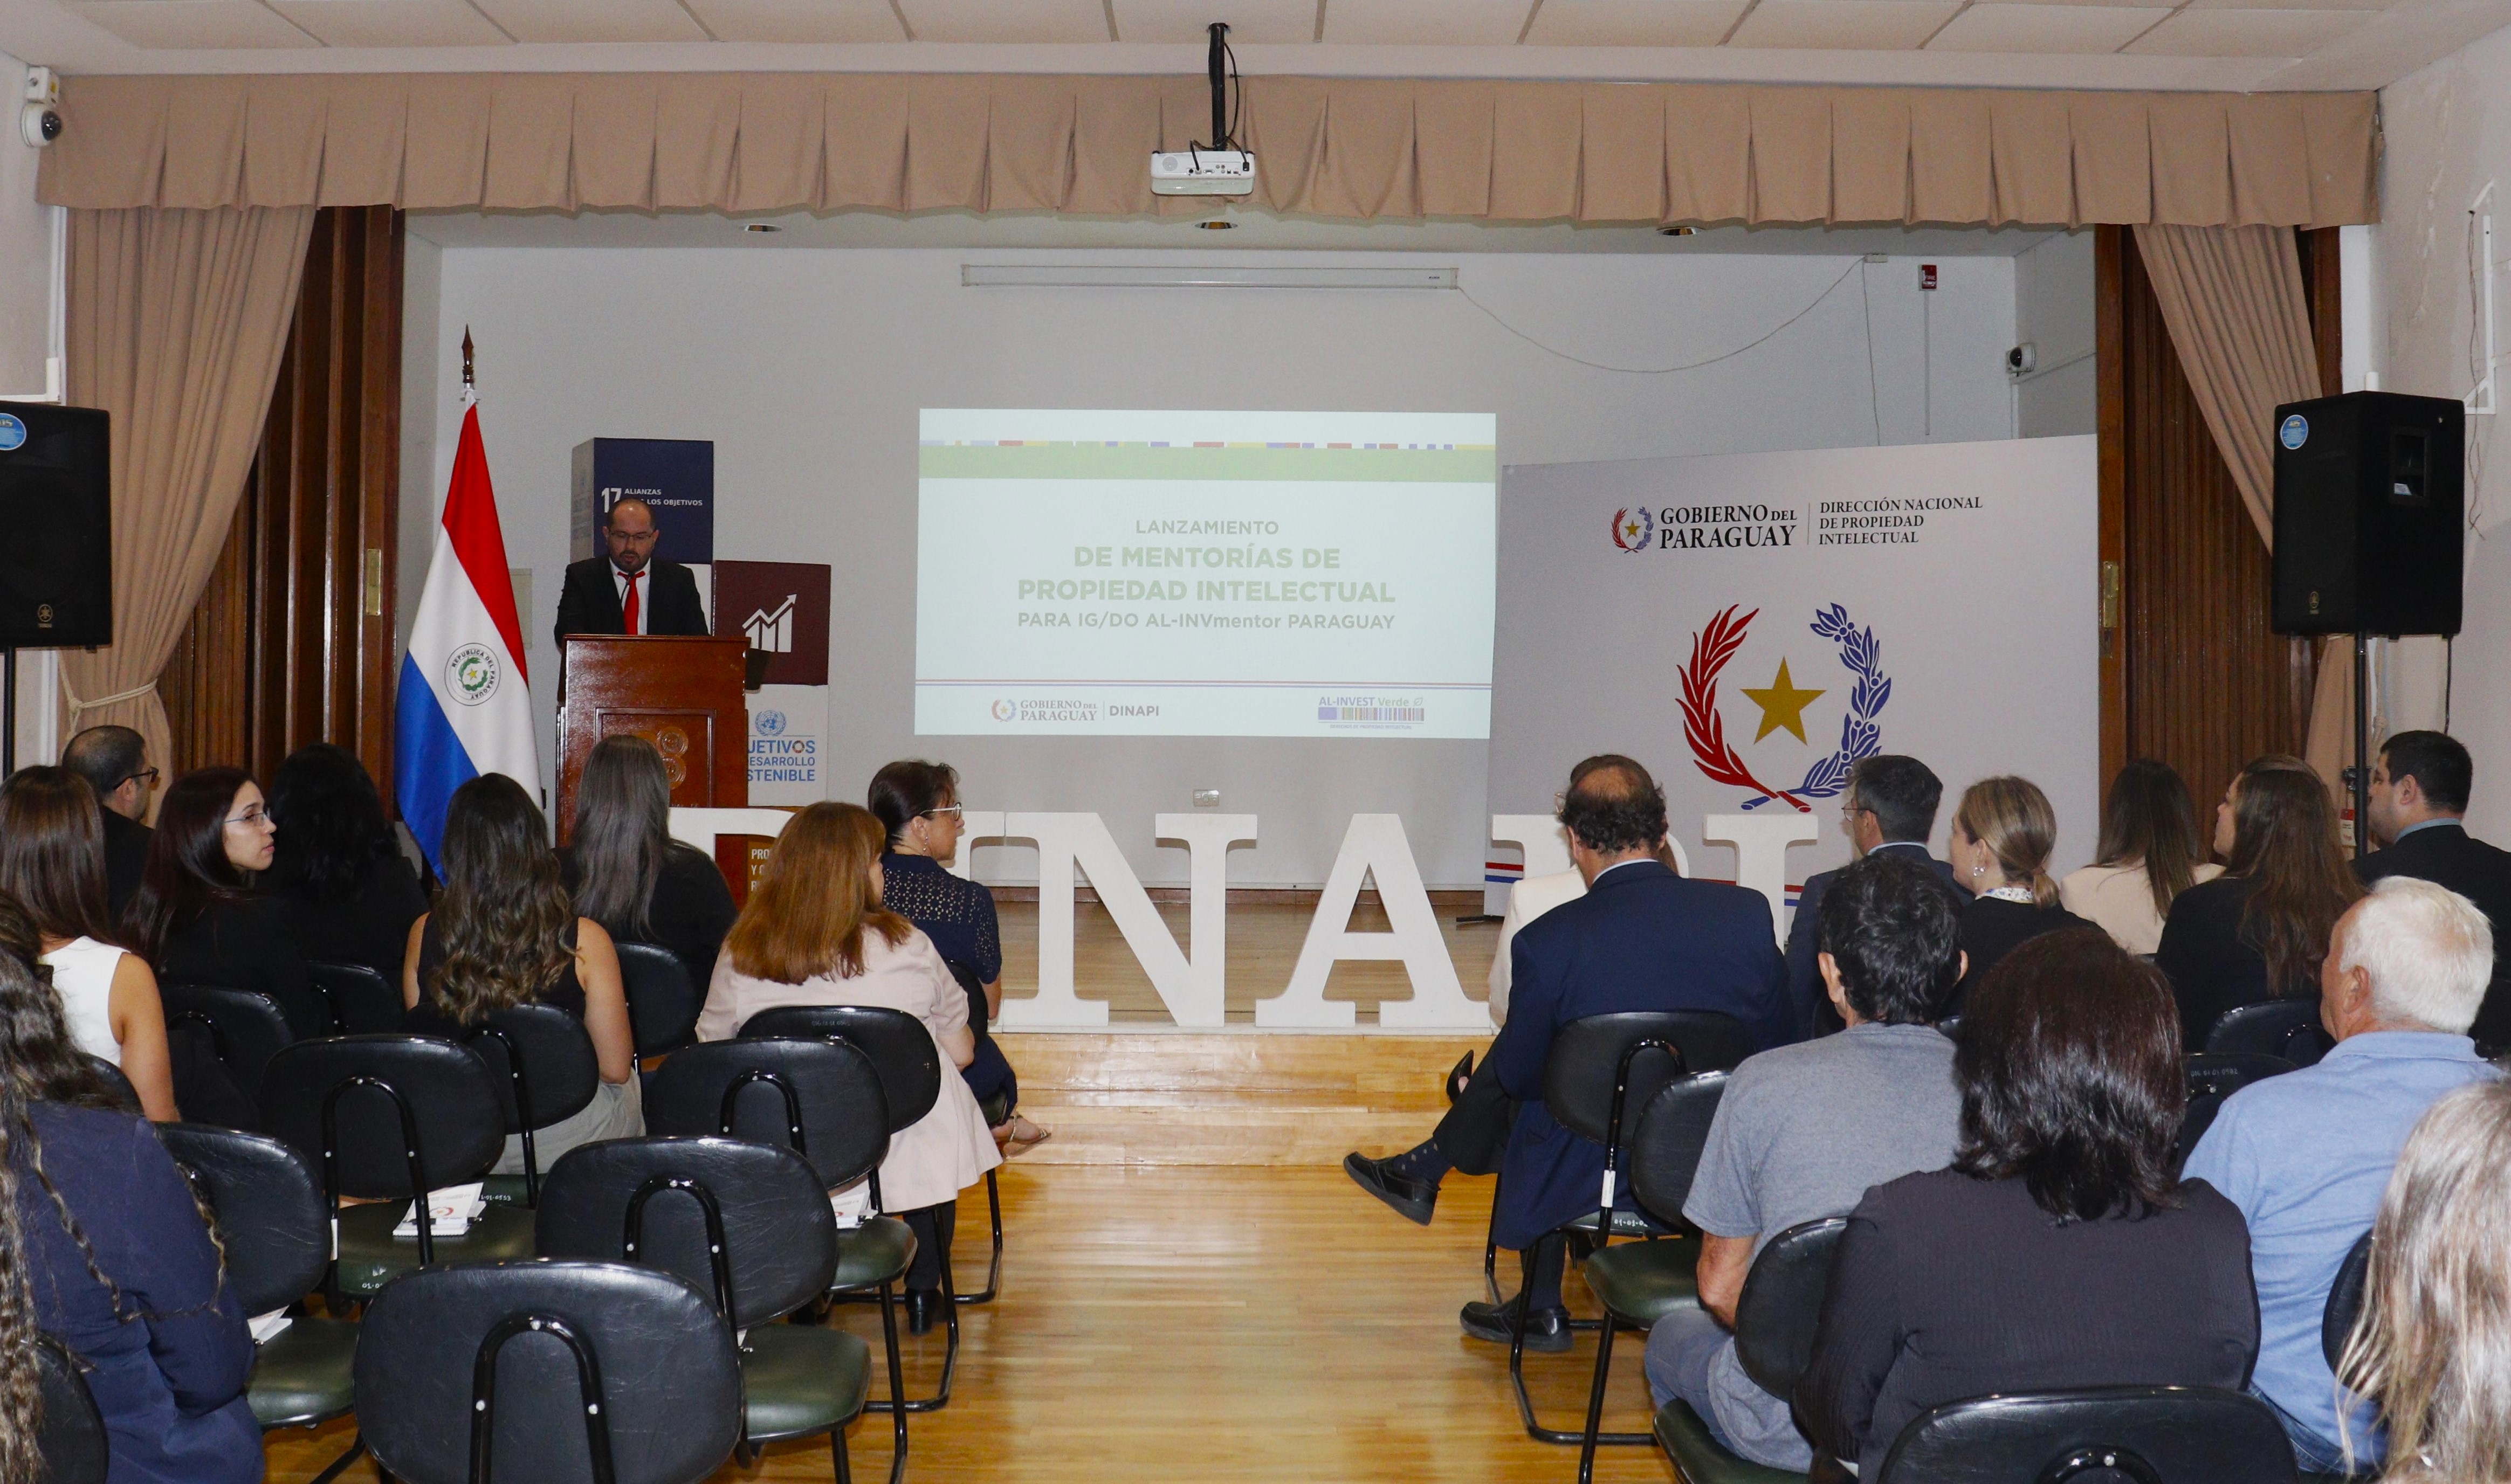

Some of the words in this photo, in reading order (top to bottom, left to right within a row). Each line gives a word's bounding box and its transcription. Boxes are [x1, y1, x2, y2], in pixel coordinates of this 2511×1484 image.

[1820, 497, 1901, 513] DIRECCIÓN
[1904, 496, 1983, 510] NACIONAL
[1661, 505, 1768, 524] GOBIERNO
[1771, 510, 1797, 521] DEL
[1820, 518, 1838, 529] DE
[1841, 515, 1924, 528] PROPIEDAD
[1136, 520, 1279, 535] LANZAMIENTO
[1660, 525, 1797, 549] PARAGUAY
[1819, 532, 1919, 545] INTELECTUAL
[1074, 546, 1112, 567] DE
[1122, 542, 1293, 568] MENTORÍAS
[1303, 548, 1340, 569] DE
[1018, 579, 1187, 600] PROPIEDAD
[1196, 581, 1396, 603] INTELECTUAL
[1018, 612, 1071, 627] PARA
[1078, 611, 1139, 629] IG/DO
[1145, 613, 1282, 628] AL-INVmentor
[1288, 614, 1395, 630] PARAGUAY
[471, 671, 495, 700] PARAGUAY
[1020, 700, 1082, 709] GOBIERNO
[1319, 696, 1375, 706] AL-INVEST
[1378, 697, 1409, 707] Verde
[1020, 710, 1098, 721] PARAGUAY
[1109, 706, 1159, 716] DINAPI
